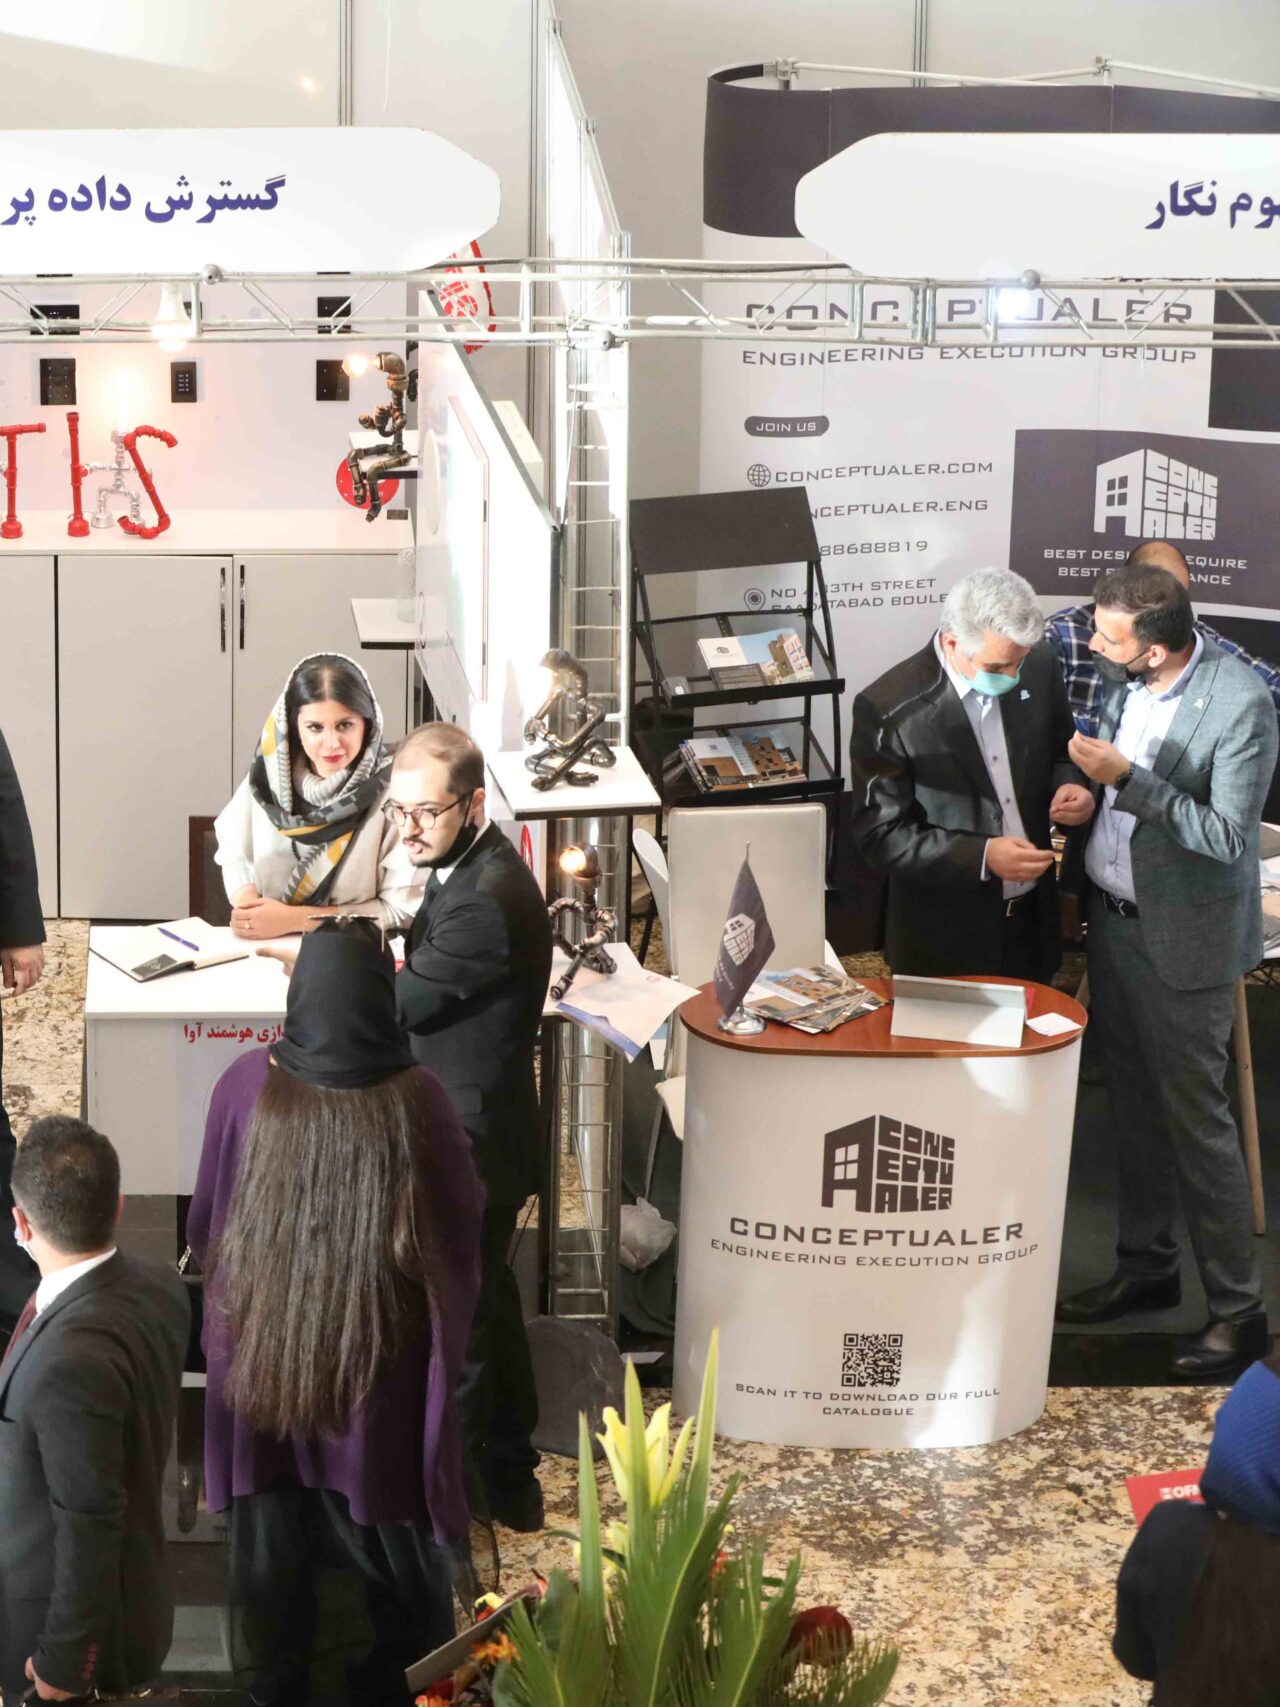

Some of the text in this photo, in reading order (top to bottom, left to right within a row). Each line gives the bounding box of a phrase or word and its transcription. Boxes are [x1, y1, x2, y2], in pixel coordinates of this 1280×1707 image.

[47, 175, 132, 212] داده
[144, 174, 286, 224] گسترش
[1144, 180, 1217, 230] نگار
[742, 347, 924, 366] ENGINEERING
[1102, 347, 1196, 364] GROUP
[755, 421, 817, 433] JOIN US
[775, 461, 993, 483] CONCEPTUALER.COM
[810, 500, 989, 519] NCEPTUALER.ENG
[1043, 549, 1087, 560] BEST
[1184, 554, 1248, 570] EQUIRE
[1058, 567, 1100, 578] BEST
[771, 588, 797, 599] NO
[870, 578, 937, 592] STREET
[184, 1021, 204, 1043] آوا
[207, 1024, 254, 1044] هوشمند
[729, 1216, 1024, 1248] CONCEPTUALER
[711, 1237, 1039, 1268] ENGINEERING EXECUTION GROUP
[735, 1383, 1001, 1402] SCAN IT TO DOWNLOAD OUR FULL
[822, 1407, 915, 1417] CATALOGUE
